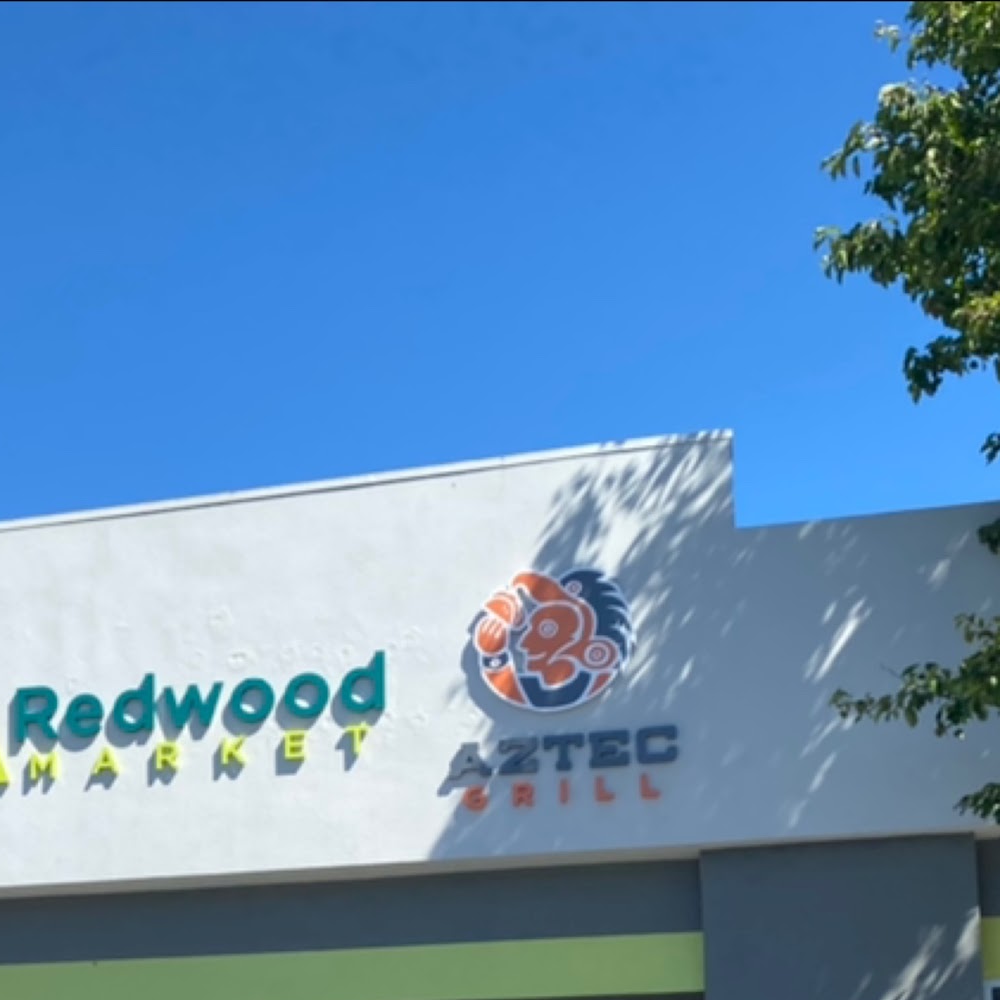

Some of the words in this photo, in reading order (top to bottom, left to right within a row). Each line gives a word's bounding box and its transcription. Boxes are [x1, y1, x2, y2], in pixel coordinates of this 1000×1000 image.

[13, 650, 386, 744] Redwood
[30, 722, 370, 781] MARKET
[447, 725, 680, 780] AZTEC
[462, 772, 662, 812] GRILL
